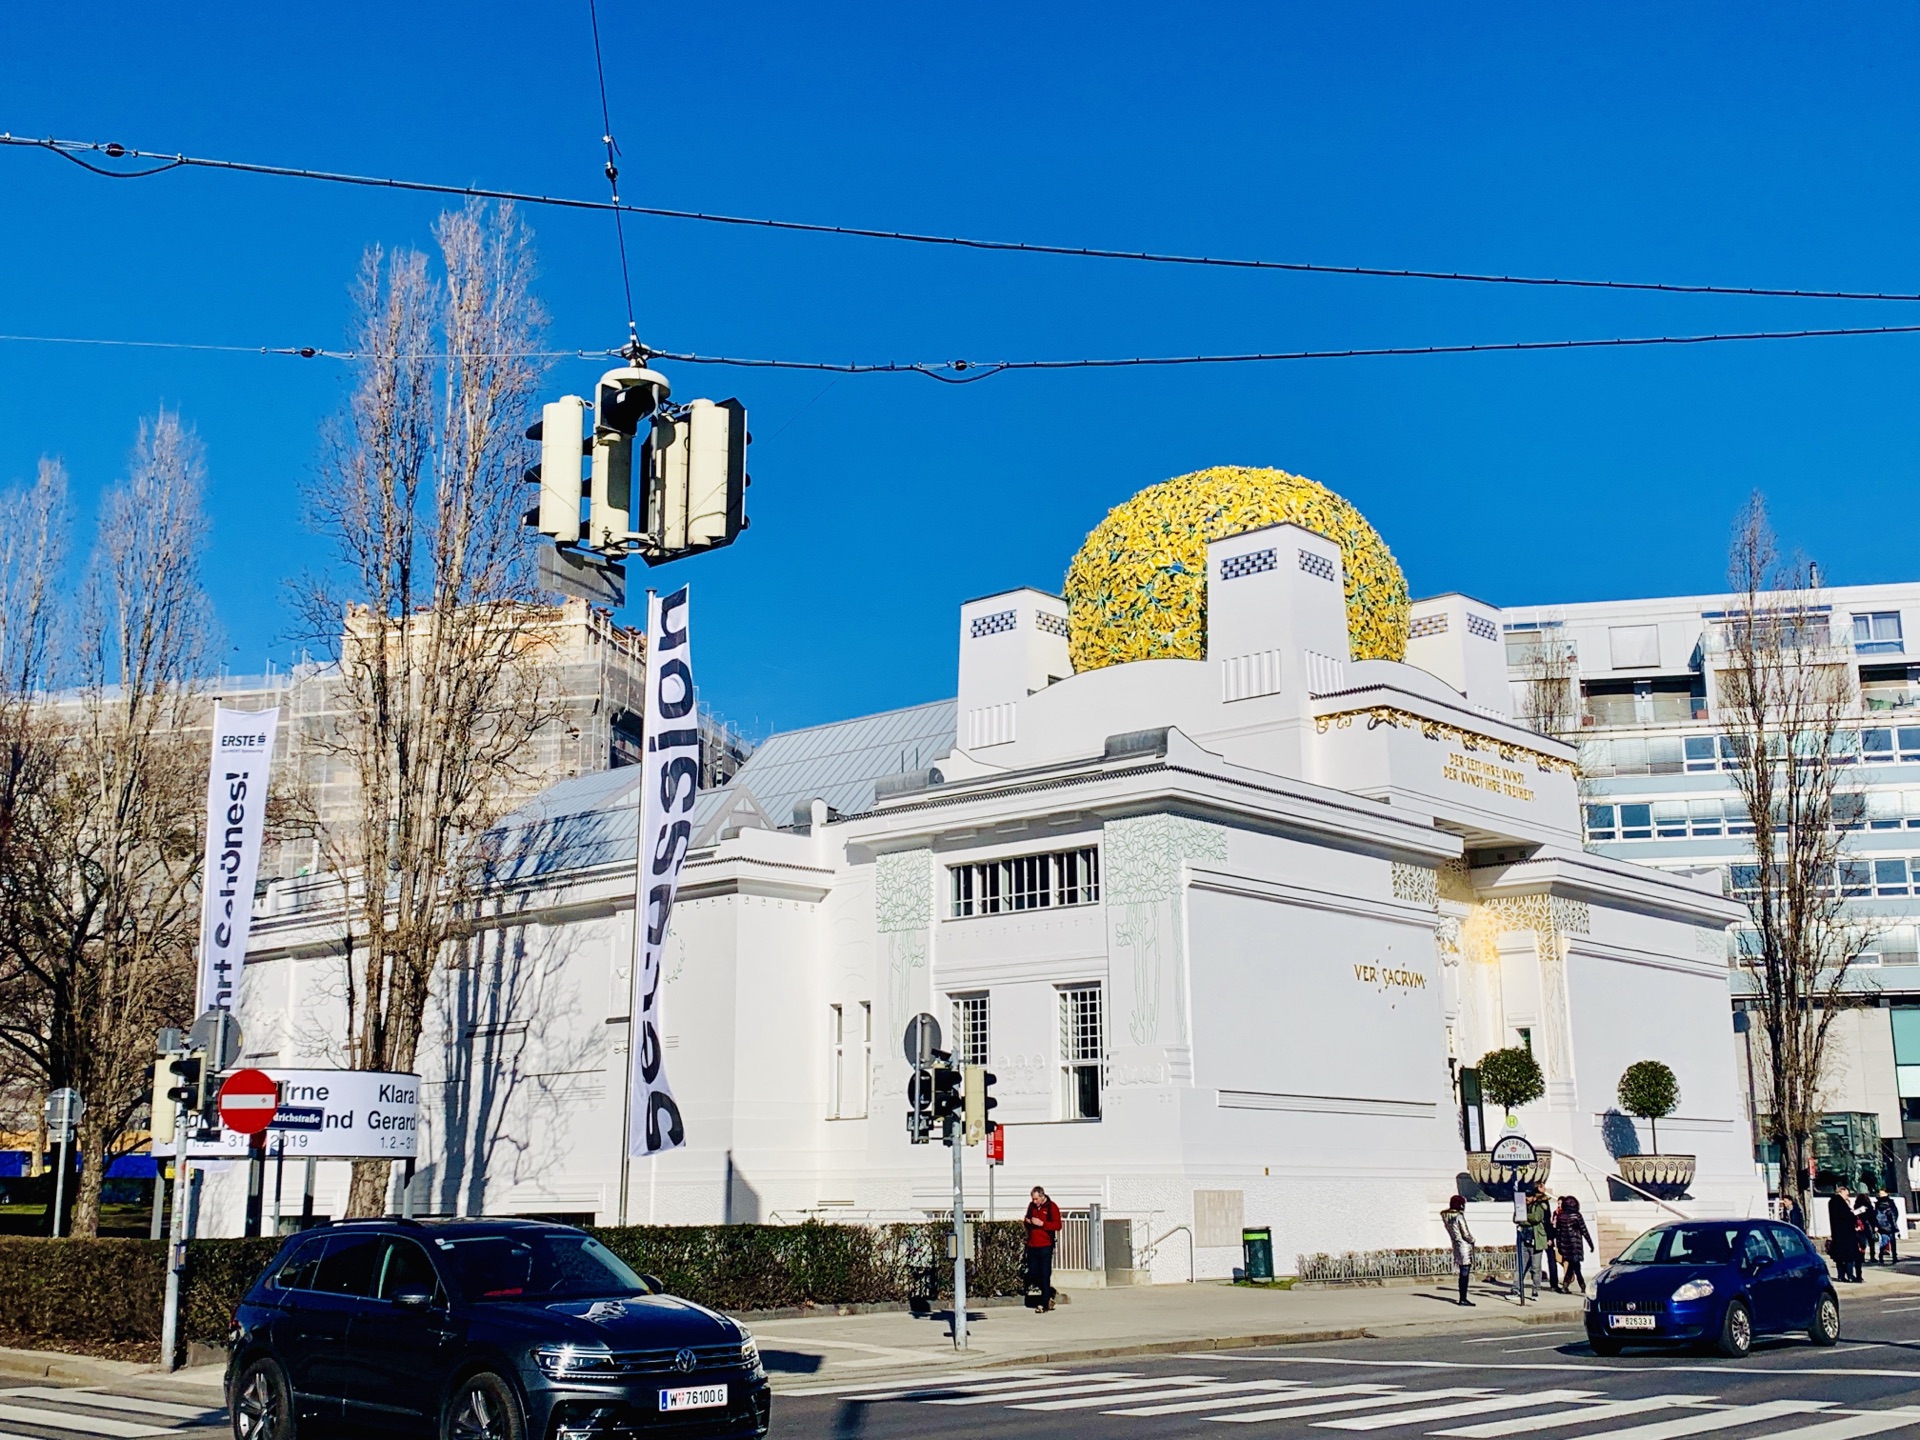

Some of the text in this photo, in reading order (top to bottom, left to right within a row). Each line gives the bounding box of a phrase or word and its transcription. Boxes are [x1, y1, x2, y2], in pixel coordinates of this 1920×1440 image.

[222, 735, 255, 747] ERSTE
[1449, 753, 1464, 767] DER
[1483, 762, 1500, 778] IHRE
[1443, 766, 1458, 780] DER
[1485, 778, 1501, 793] IHRE
[1354, 964, 1377, 982] VER
[209, 960, 232, 1012] hrt
[288, 1086, 329, 1101] rne
[379, 1084, 414, 1104] Klara
[273, 1112, 321, 1123] drichstraße
[326, 1110, 353, 1129] nd
[368, 1110, 416, 1131] Gerard
[270, 1134, 308, 1148] 2019
[1501, 1140, 1526, 1149] AUTOBUS
[670, 1389, 724, 1407] W 76100 G
